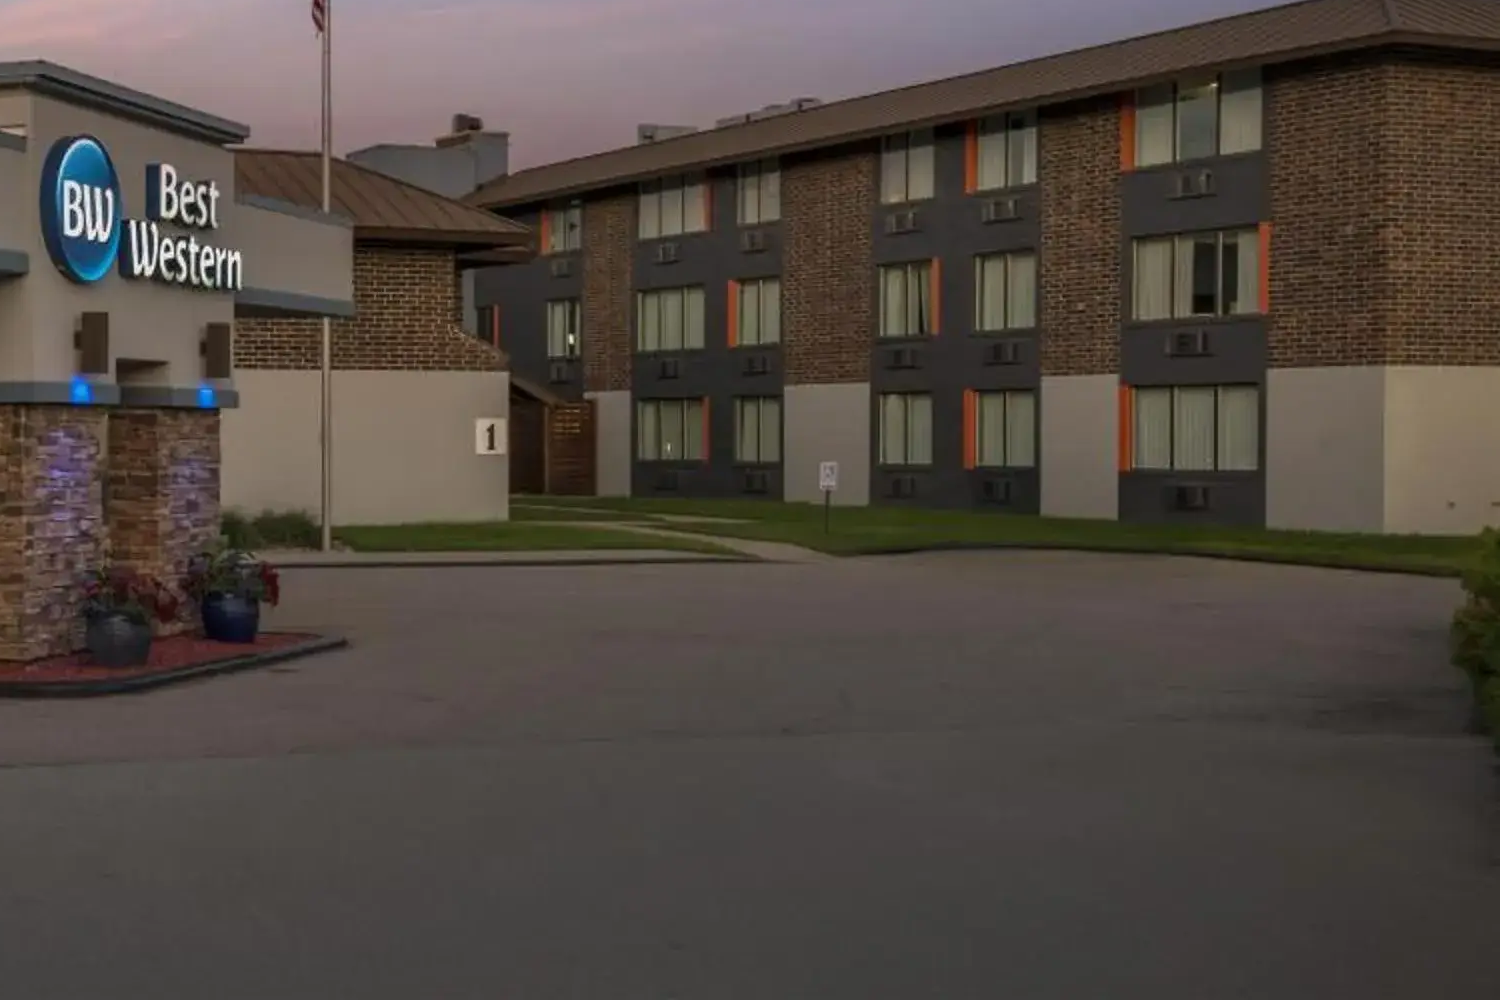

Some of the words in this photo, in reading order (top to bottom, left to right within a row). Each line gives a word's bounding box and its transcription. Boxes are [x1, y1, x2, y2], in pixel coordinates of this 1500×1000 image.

[63, 179, 114, 243] BW
[160, 164, 220, 229] Best
[129, 219, 242, 291] Western
[486, 423, 496, 451] 1
